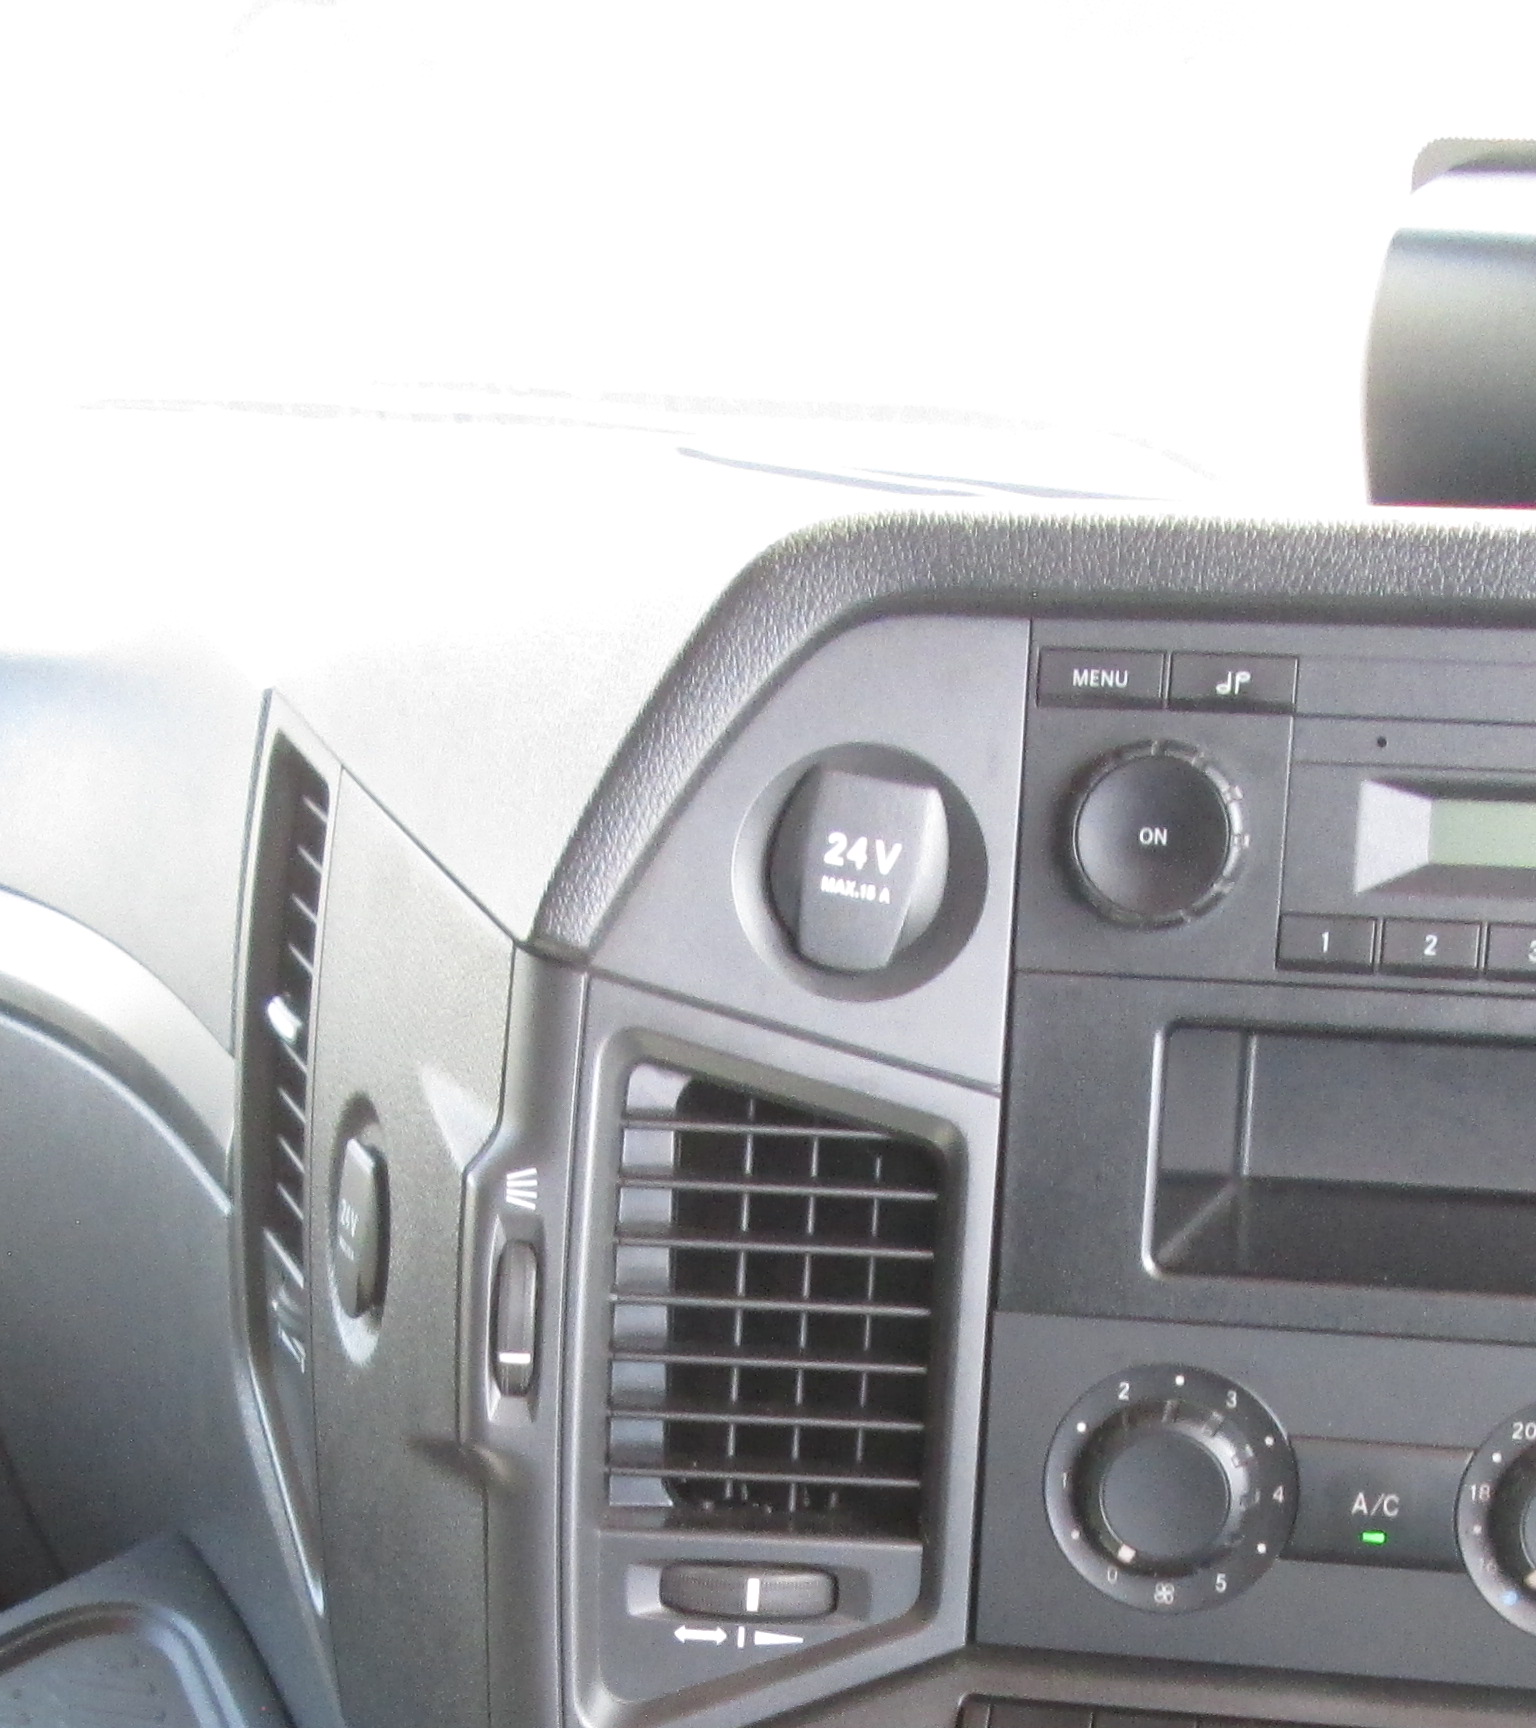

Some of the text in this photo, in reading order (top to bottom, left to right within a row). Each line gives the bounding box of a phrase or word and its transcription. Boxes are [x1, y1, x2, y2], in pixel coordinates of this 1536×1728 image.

[1072, 668, 1129, 690] MENU
[1139, 827, 1168, 846] ON
[1321, 931, 1330, 953] 1
[1424, 934, 1439, 956] 2
[1118, 1381, 1131, 1401] 2
[1226, 1390, 1238, 1409] 3
[1271, 1484, 1285, 1504] 4
[1470, 1483, 1491, 1501] 18
[1351, 1491, 1400, 1518] A/C
[1215, 1573, 1228, 1593] 5
